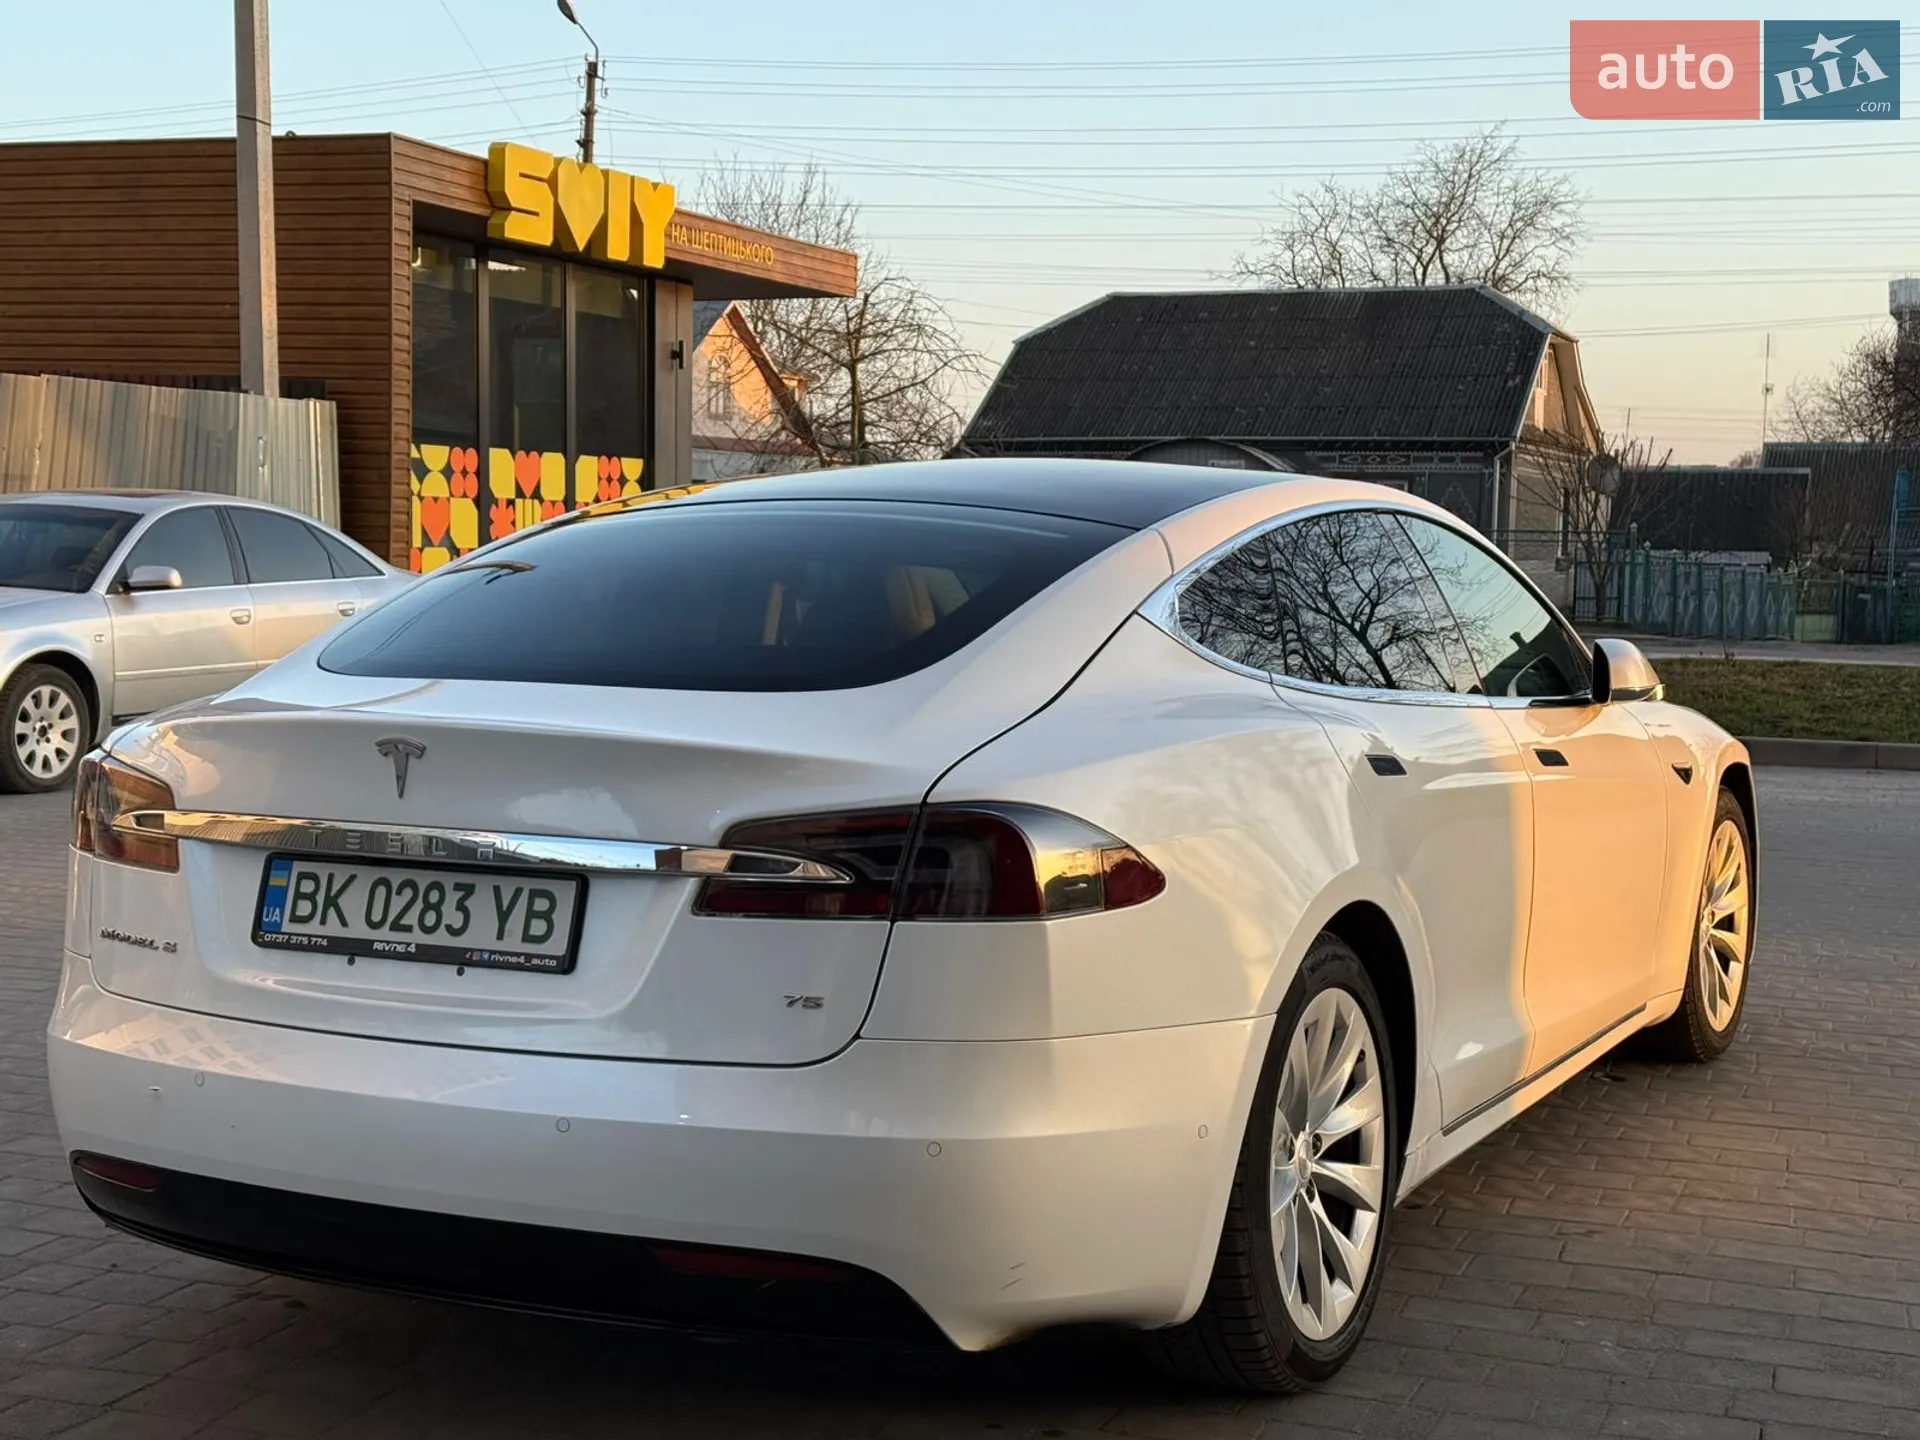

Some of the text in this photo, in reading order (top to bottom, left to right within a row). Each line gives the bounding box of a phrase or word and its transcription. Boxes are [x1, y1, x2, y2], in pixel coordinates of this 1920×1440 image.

[671, 223, 774, 266] НА ШЕПТИЦЬКОГО
[262, 906, 281, 923] UA
[288, 871, 557, 945] BK 0283 YB
[264, 934, 328, 947] 0737 375 774
[490, 953, 557, 967] rivne4_auto
[783, 994, 825, 1009] 75
